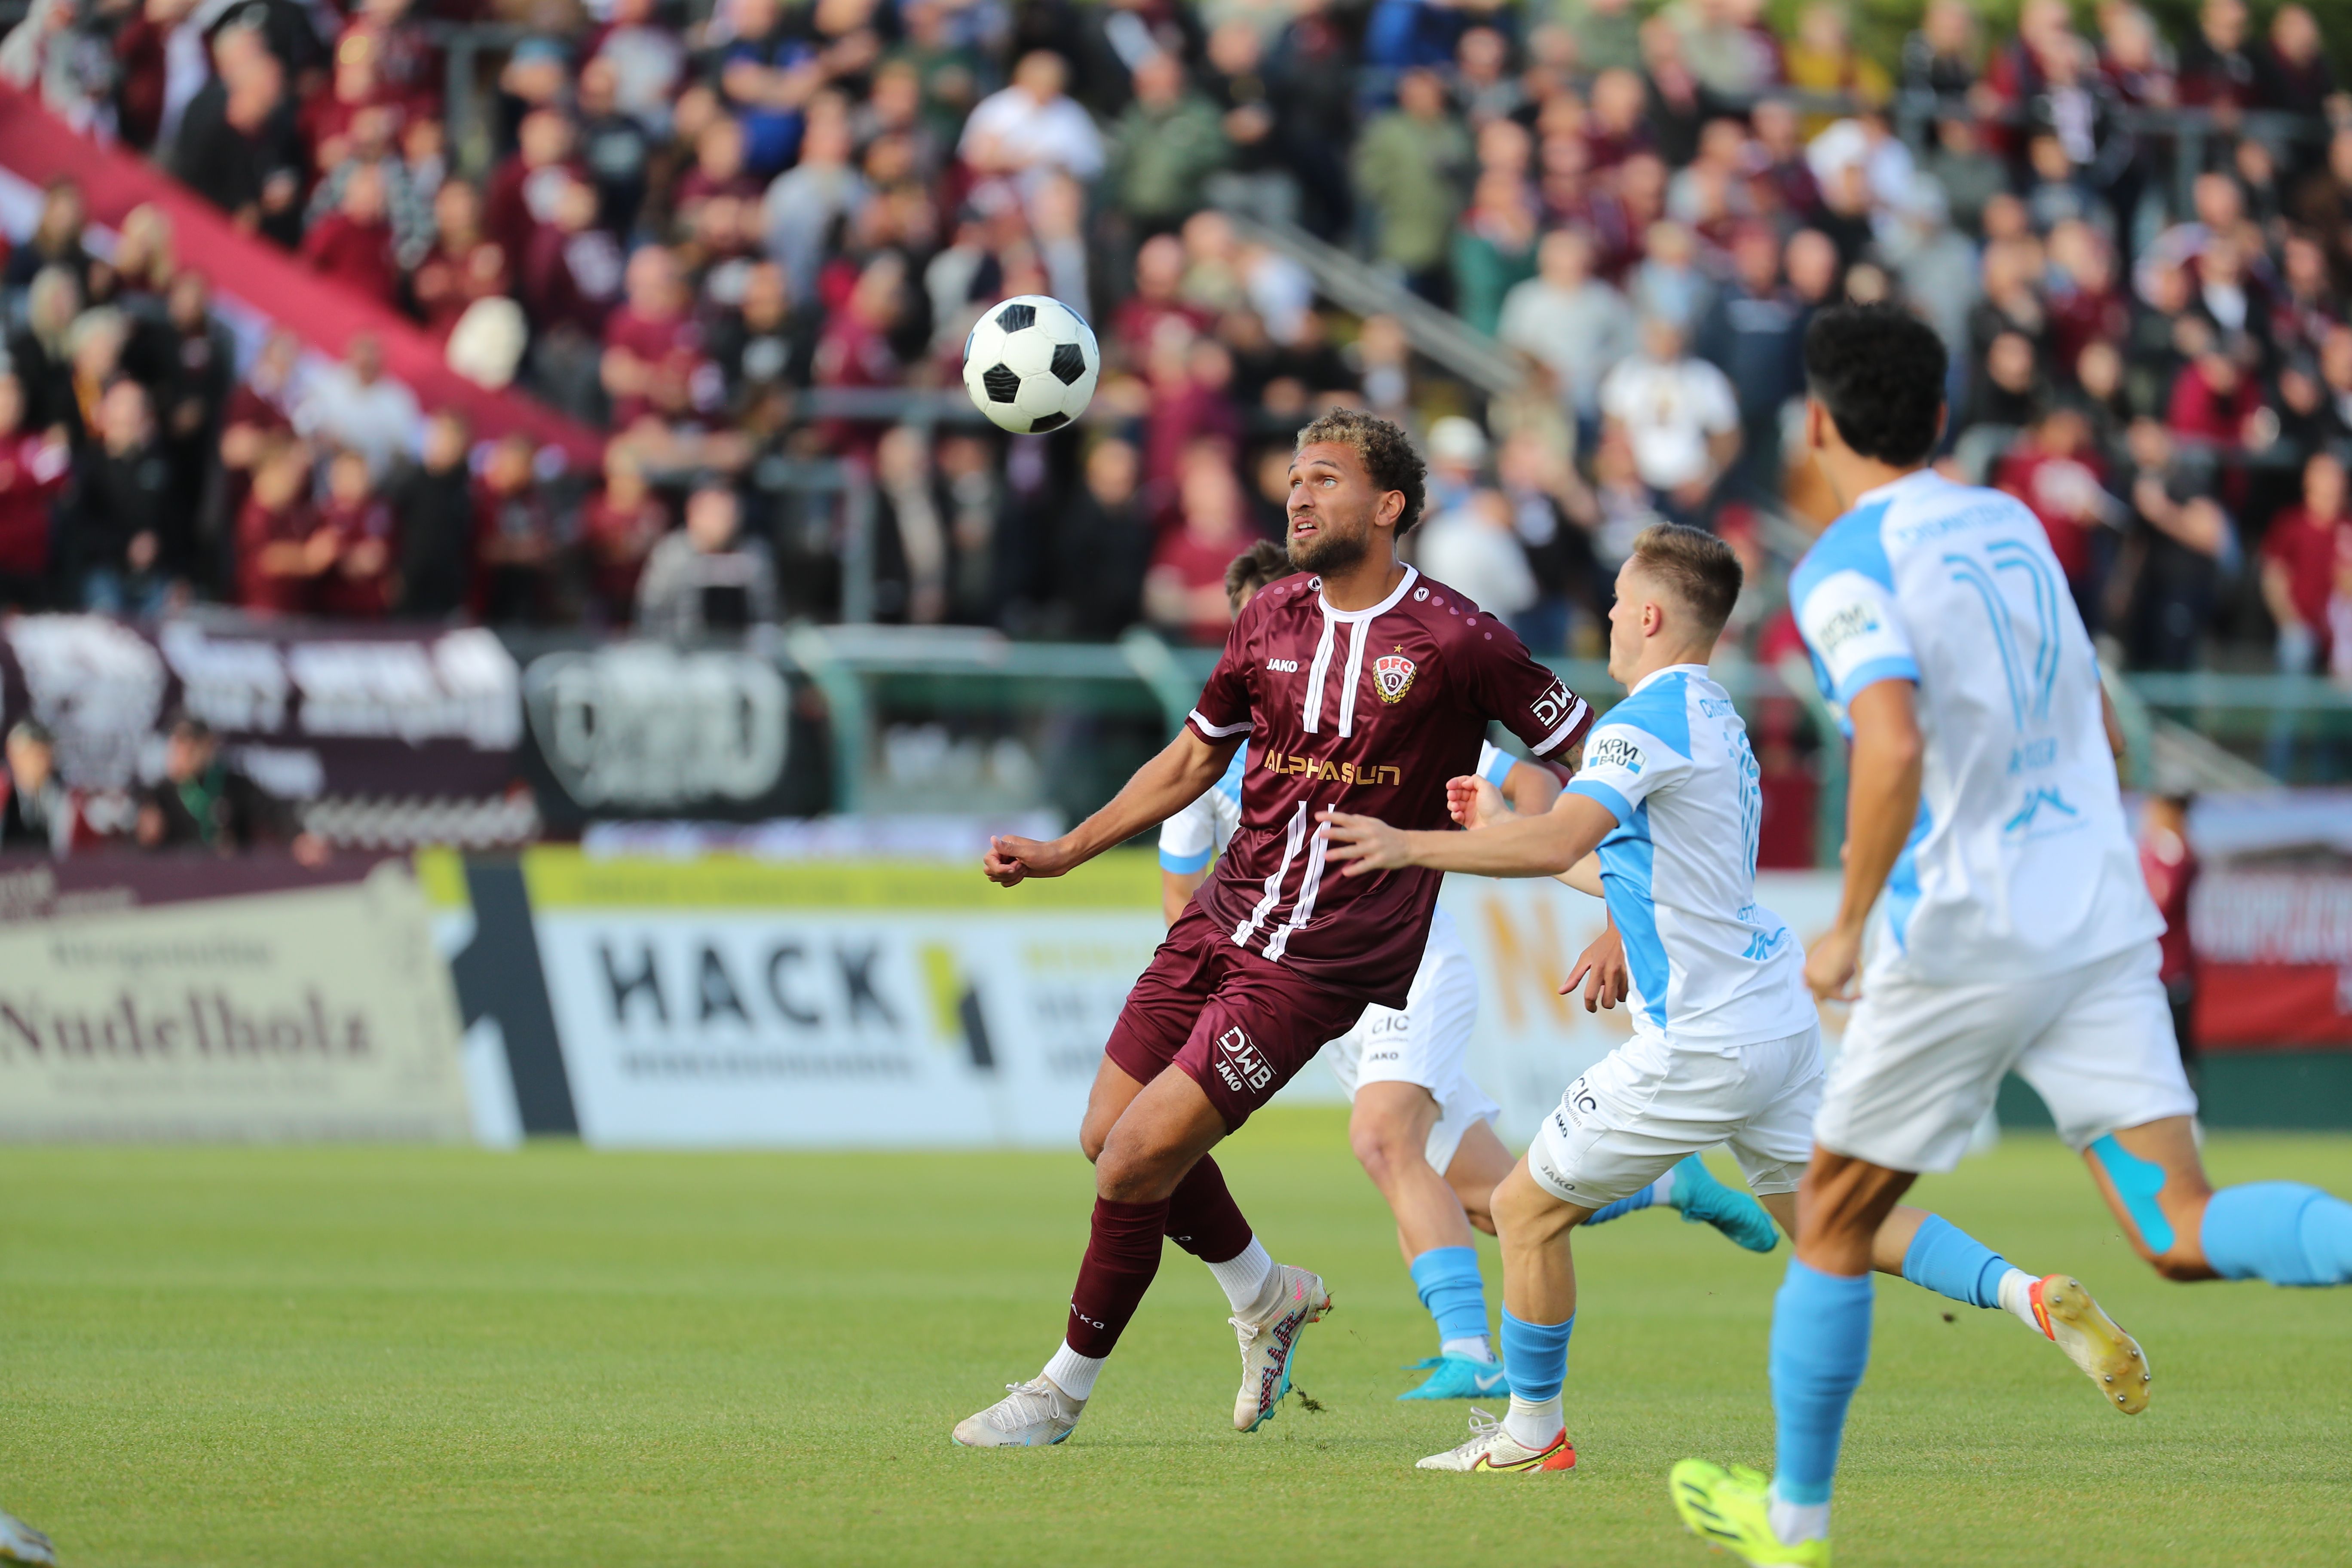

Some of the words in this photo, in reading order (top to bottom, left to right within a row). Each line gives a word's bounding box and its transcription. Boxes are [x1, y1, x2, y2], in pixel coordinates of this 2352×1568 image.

[1942, 539, 2061, 732] 17
[1266, 658, 1298, 673] JAKO
[1378, 658, 1412, 674] BFC
[1532, 677, 1573, 727] DW
[597, 932, 901, 1027] HACK
[0, 988, 371, 1062] Nudelholz
[1215, 1060, 1242, 1091] JAKO
[1219, 1026, 1272, 1089] DWB
[1556, 1109, 1568, 1139] AKO
[1540, 1165, 1575, 1191] JAKO
